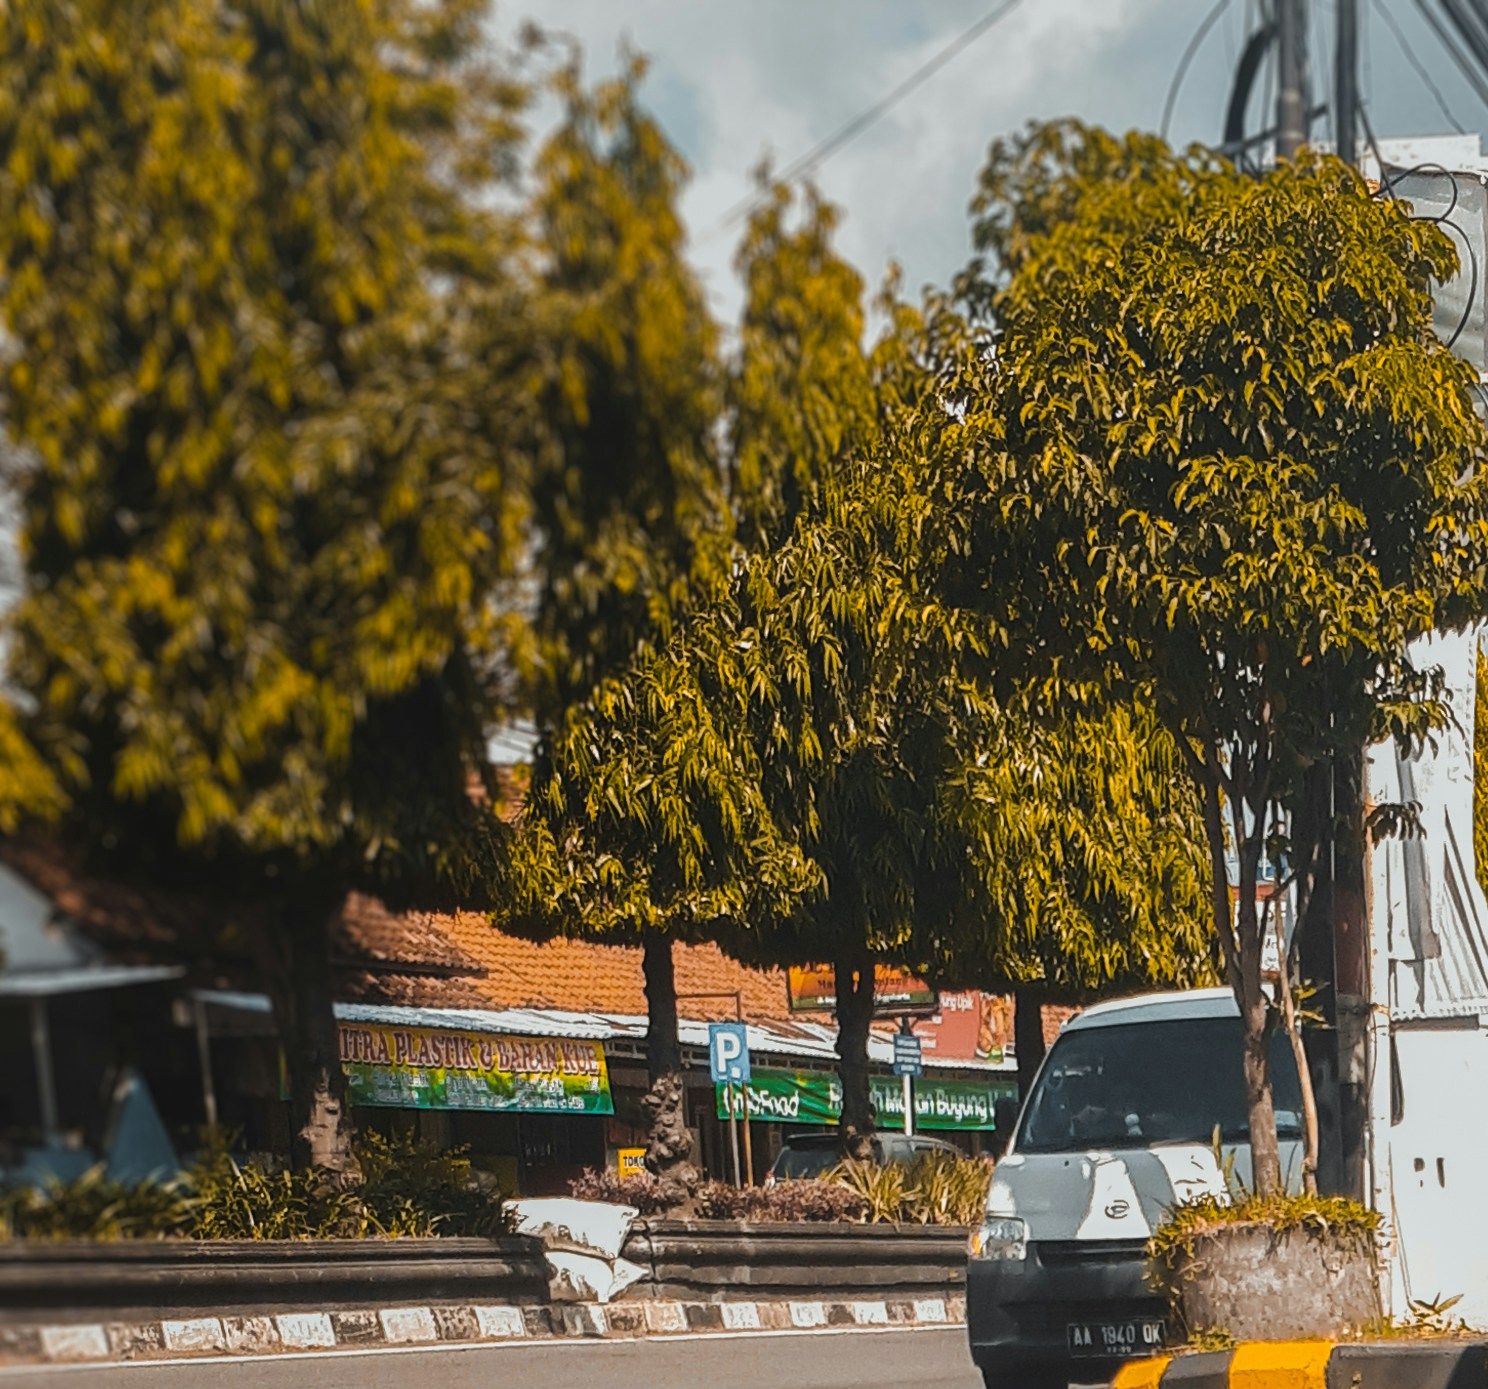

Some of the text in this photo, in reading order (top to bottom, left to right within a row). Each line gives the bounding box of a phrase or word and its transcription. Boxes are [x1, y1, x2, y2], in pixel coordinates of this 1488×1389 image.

[338, 1028, 600, 1076] ITRA PLASTIK & BAHAN KUE
[936, 1089, 986, 1123] Buyung
[1074, 1326, 1092, 1346] AA
[1101, 1324, 1136, 1345] 1940
